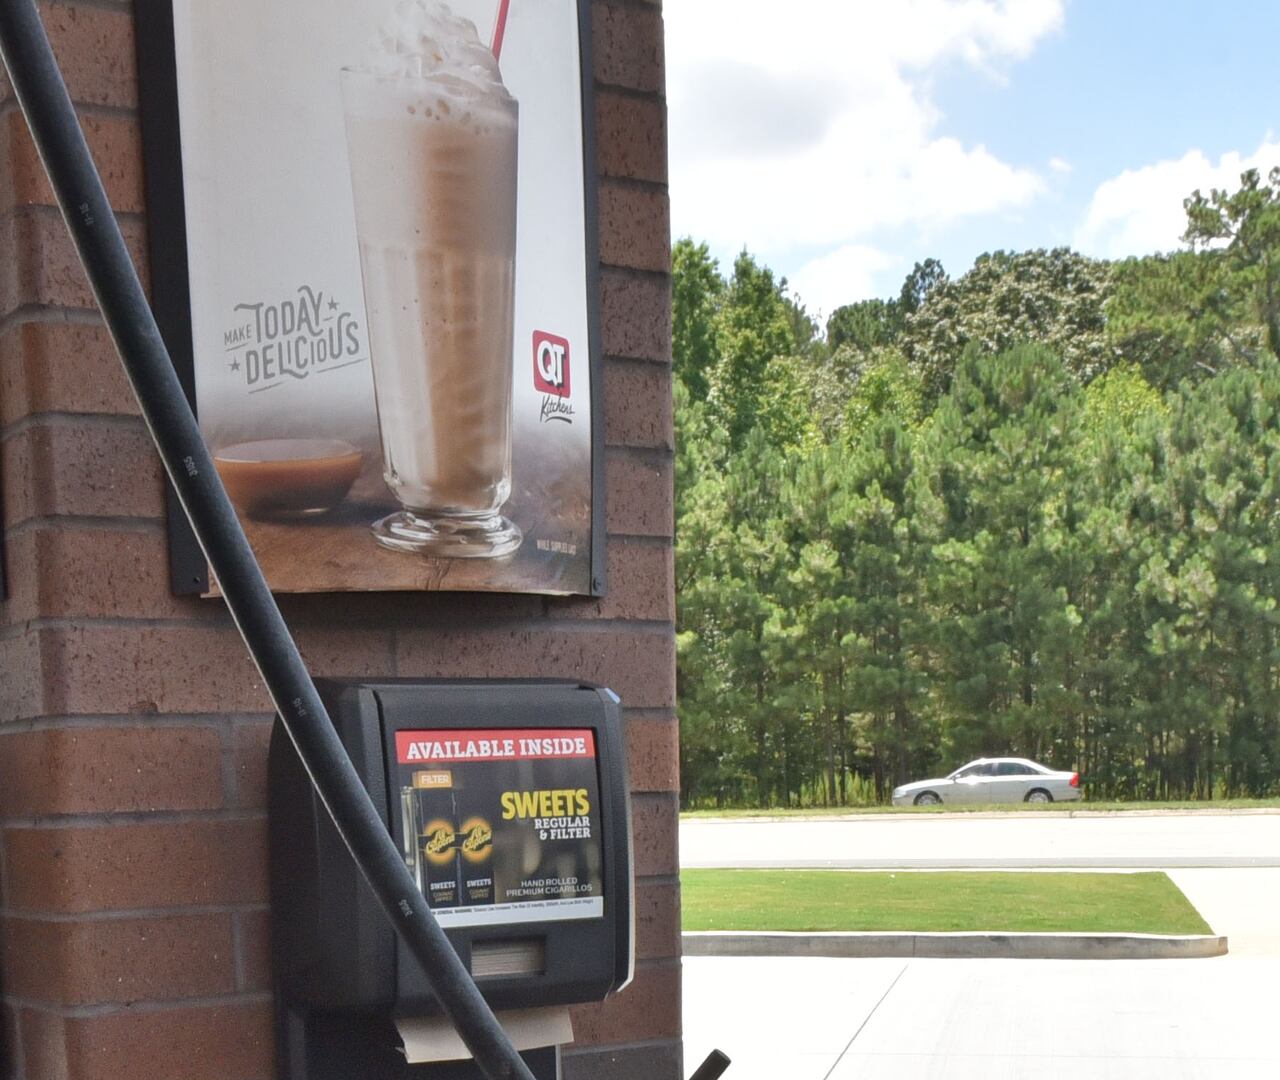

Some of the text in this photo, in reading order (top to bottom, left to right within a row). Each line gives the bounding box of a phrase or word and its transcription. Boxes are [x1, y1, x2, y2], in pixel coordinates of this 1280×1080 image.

[234, 285, 324, 343] TODAY
[224, 324, 252, 346] MAKE
[246, 312, 359, 384] DELICIOUS
[537, 340, 565, 387] QT
[540, 392, 575, 422] Kitchens
[407, 738, 586, 760] AVAILABLE INSIDE
[421, 774, 449, 785] FILTER
[501, 789, 590, 820] SWEETS
[535, 817, 590, 829] REGULAR
[539, 828, 591, 840] & FILTER
[430, 881, 455, 890] SWEETS
[467, 878, 491, 887] SWEETS
[506, 884, 592, 897] PREMIUM CIGARILLOS
[521, 877, 577, 887] HAND ROLLED
